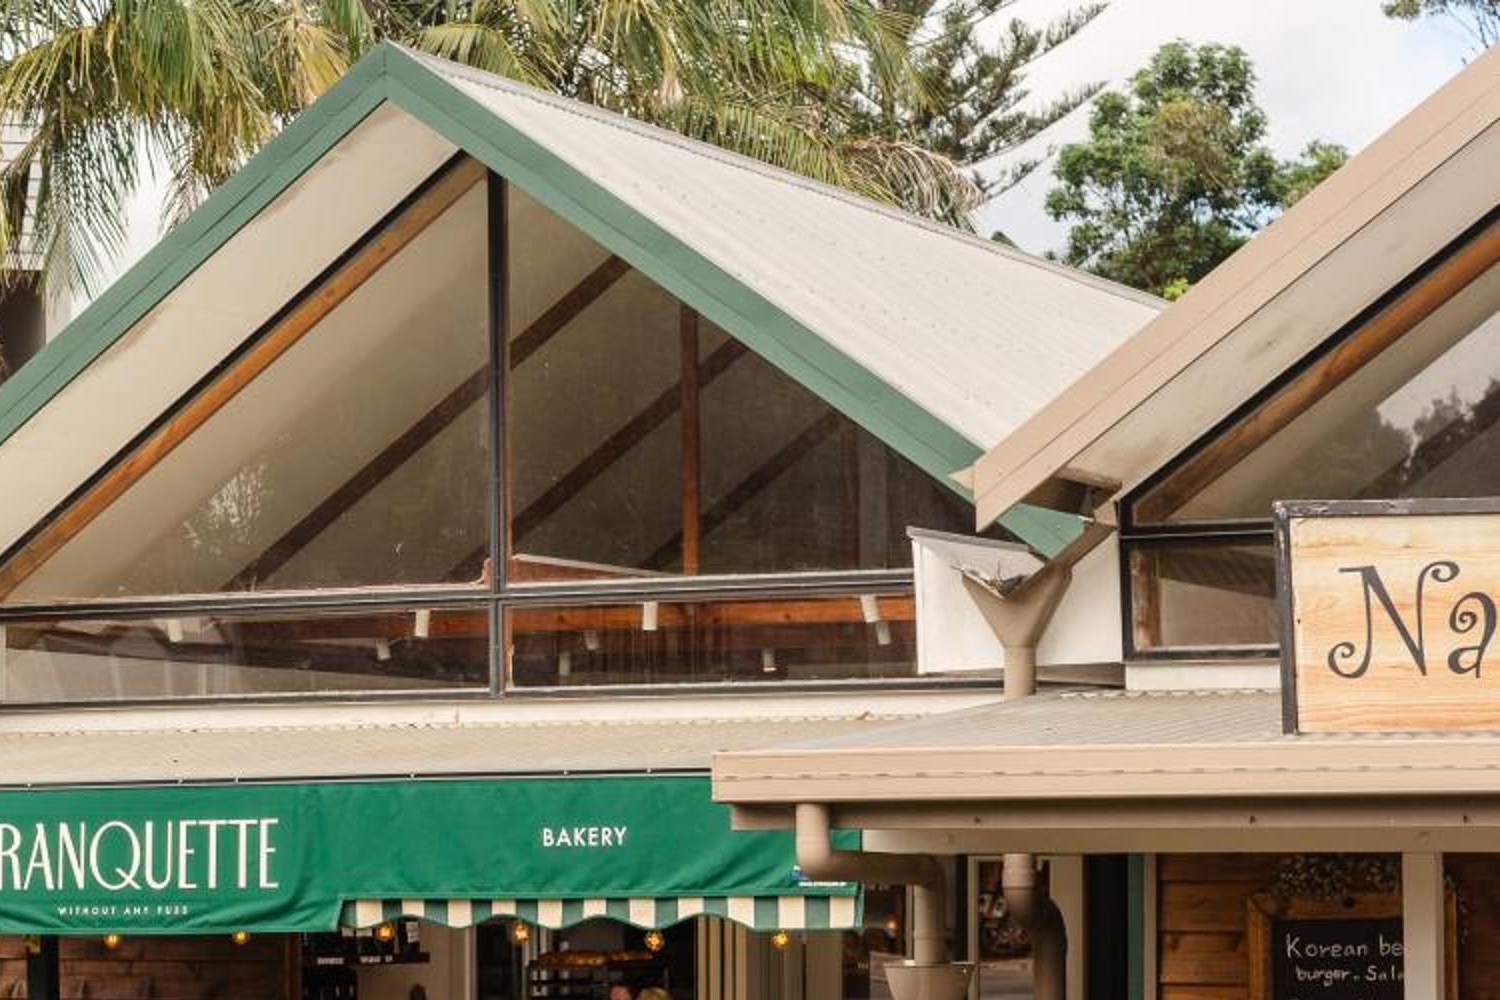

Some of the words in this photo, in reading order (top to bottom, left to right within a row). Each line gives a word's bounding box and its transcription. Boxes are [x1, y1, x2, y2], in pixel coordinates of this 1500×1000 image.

[1327, 561, 1498, 680] Na
[542, 826, 628, 848] BAKERY
[57, 905, 116, 916] WITHOUT
[123, 905, 149, 916] ANY
[157, 904, 189, 916] FUSS
[1286, 932, 1368, 959] Korean
